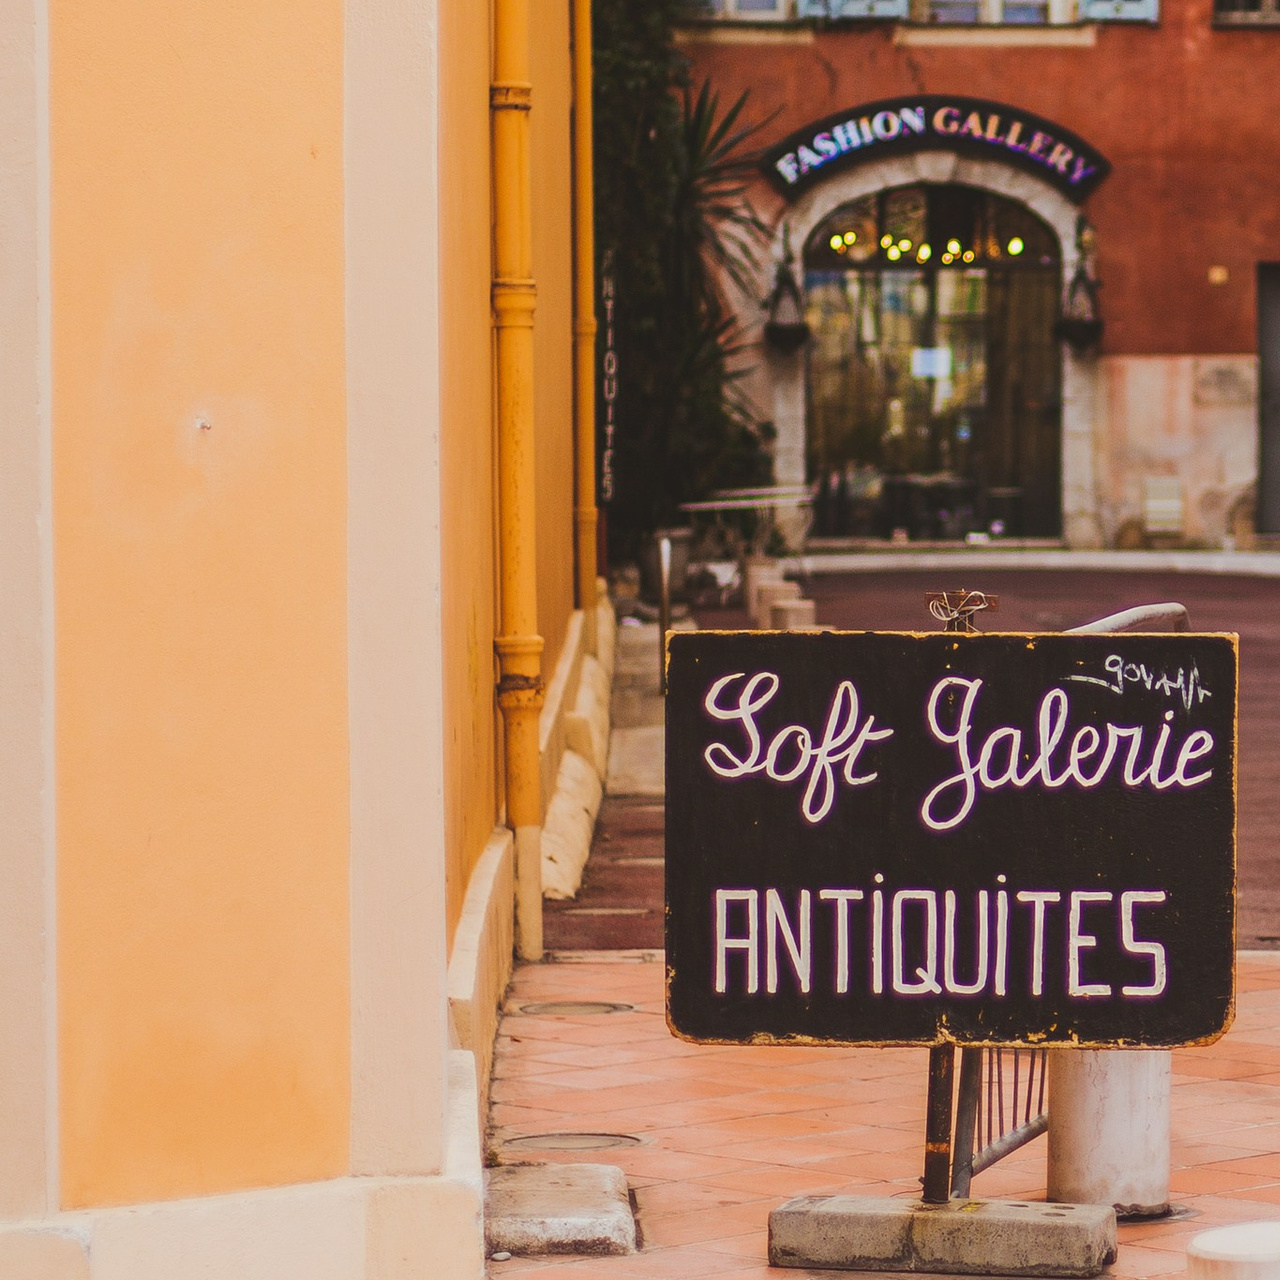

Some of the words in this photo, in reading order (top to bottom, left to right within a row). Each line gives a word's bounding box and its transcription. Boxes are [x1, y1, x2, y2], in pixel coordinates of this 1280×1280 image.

[776, 106, 926, 184] FASHION
[933, 106, 1097, 184] GALLERY
[920, 675, 1214, 830] Galerie
